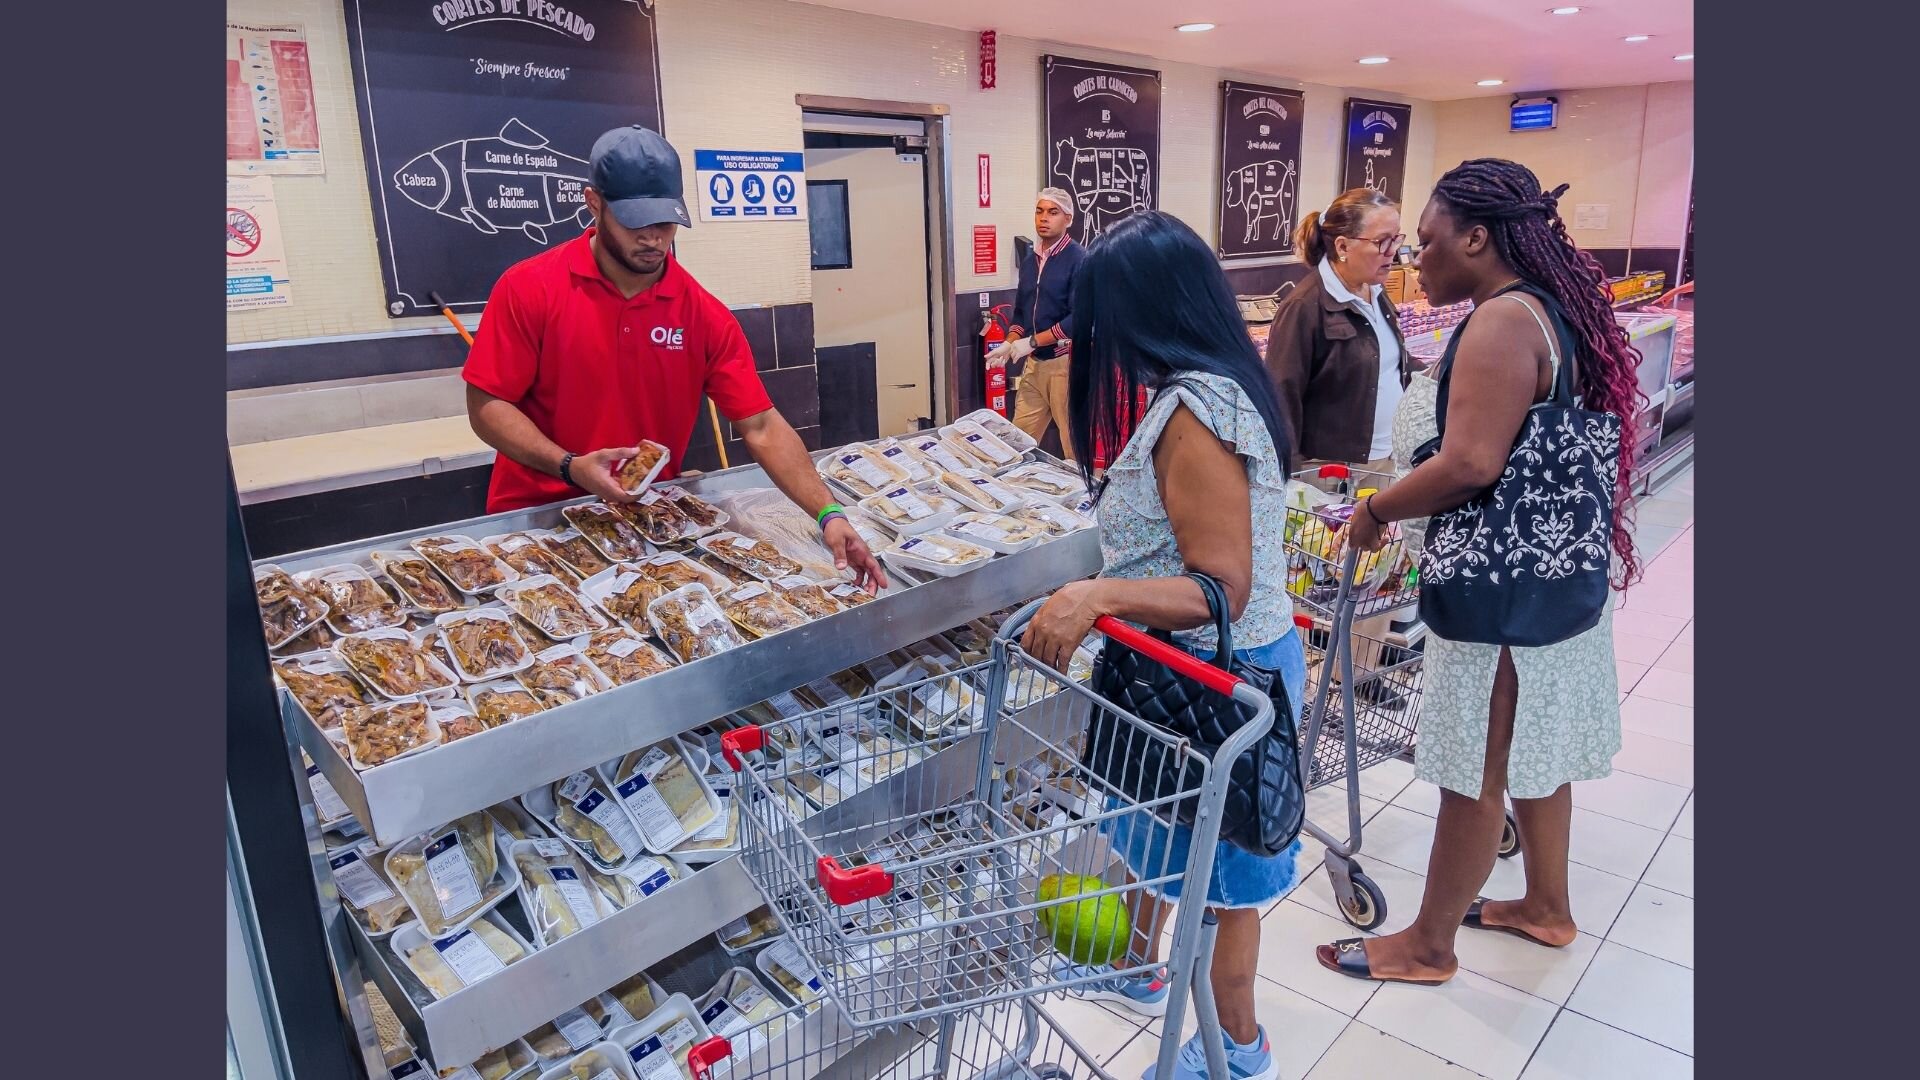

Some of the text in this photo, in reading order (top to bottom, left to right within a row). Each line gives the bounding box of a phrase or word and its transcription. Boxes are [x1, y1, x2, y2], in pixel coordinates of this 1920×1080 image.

[433, 0, 595, 42] CORTES DE PESCADO
[1073, 77, 1096, 98] CORTES
[1096, 76, 1107, 89] DEL
[486, 151, 558, 168] Carne de Espalda
[402, 174, 436, 187] Cabeza
[558, 180, 582, 191] Carne
[499, 185, 524, 197] Carne
[556, 191, 585, 203] de Cola
[487, 197, 539, 209] de Abdomen
[651, 326, 684, 344] Olé
